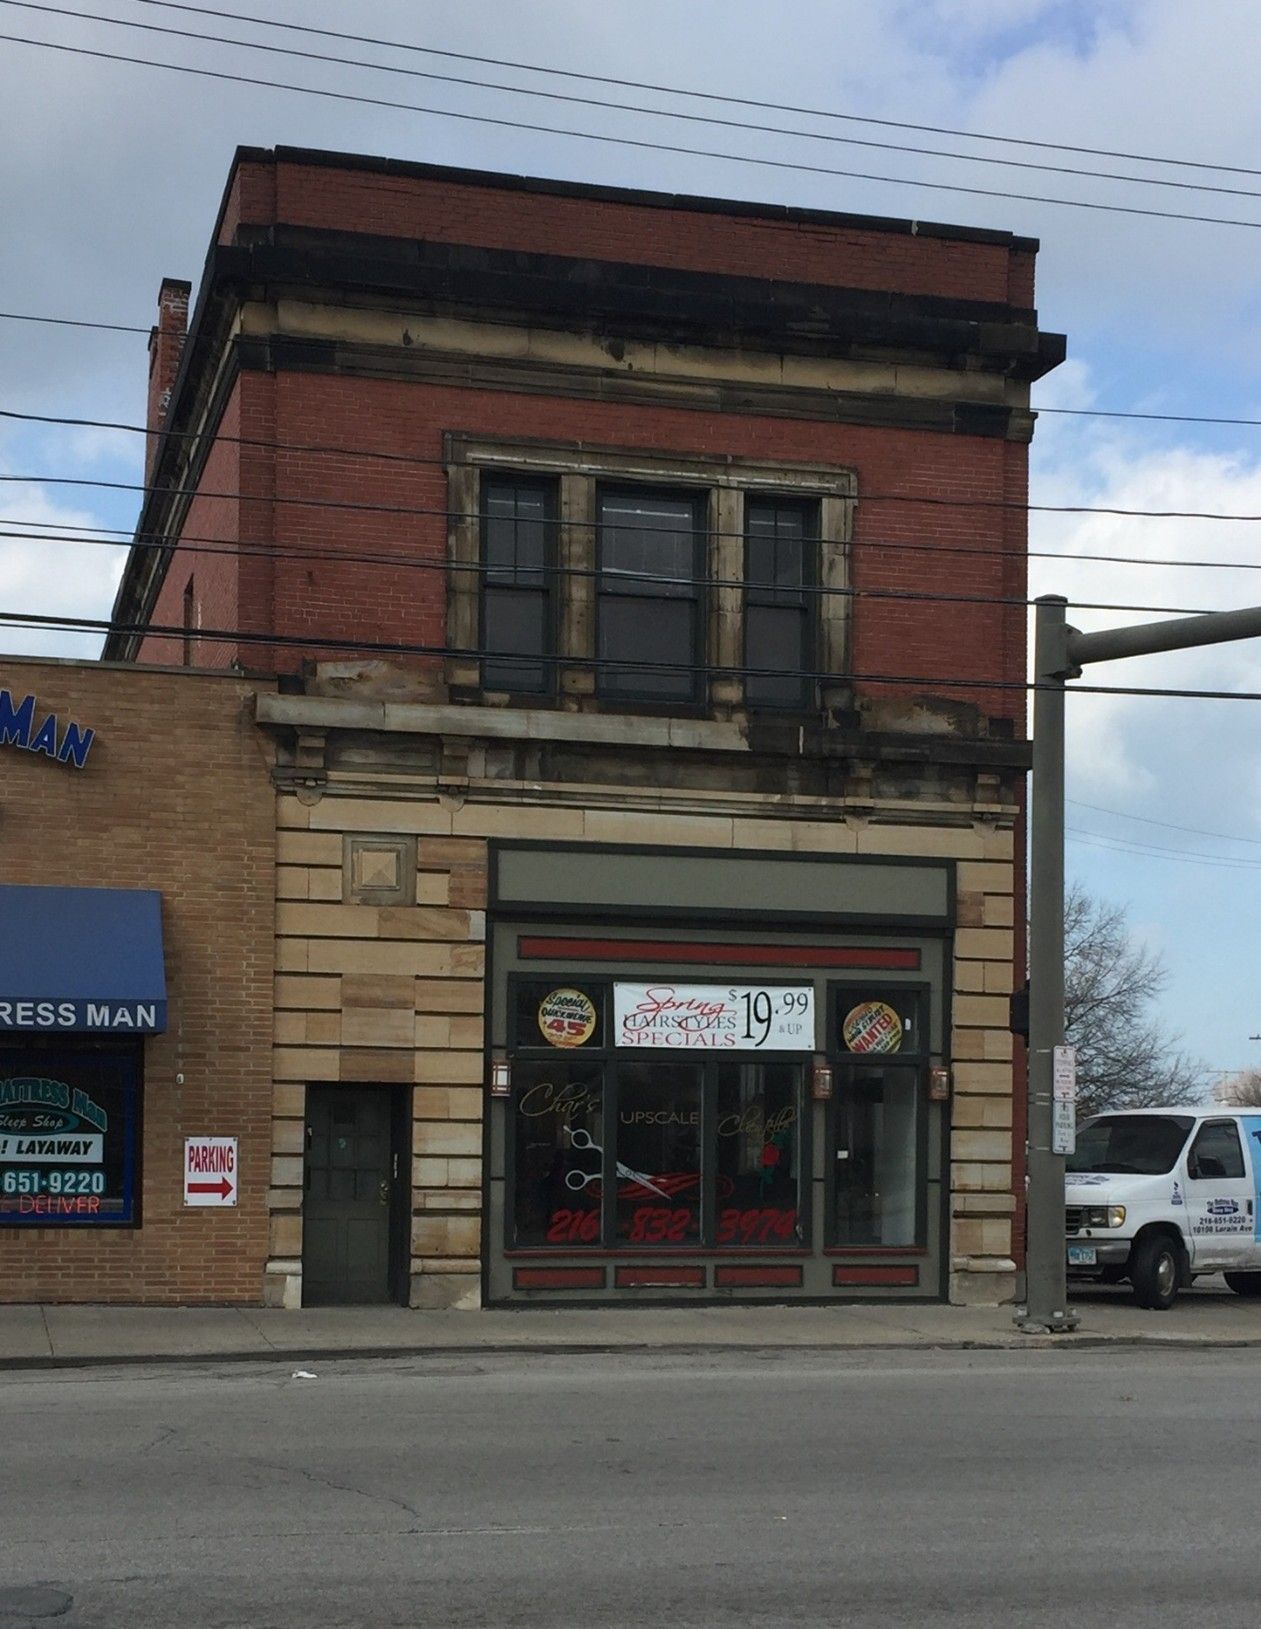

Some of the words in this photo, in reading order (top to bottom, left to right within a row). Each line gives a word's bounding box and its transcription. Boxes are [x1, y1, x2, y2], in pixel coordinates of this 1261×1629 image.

[0, 688, 96, 769] MAN
[87, 1003, 156, 1027] MAN
[623, 986, 738, 1032] Spring
[624, 1014, 737, 1030] HAIRSTYLES
[622, 1031, 736, 1047] SPECIALS
[850, 1012, 893, 1053] WANTED
[519, 1083, 600, 1120] Char's
[620, 1111, 699, 1124] UPSCALE
[32, 1114, 64, 1129] Shop
[16, 1140, 93, 1156] LAYAWAY
[188, 1145, 234, 1173] PARKING
[19, 1195, 100, 1214] DELIVER
[547, 1209, 600, 1242] 216
